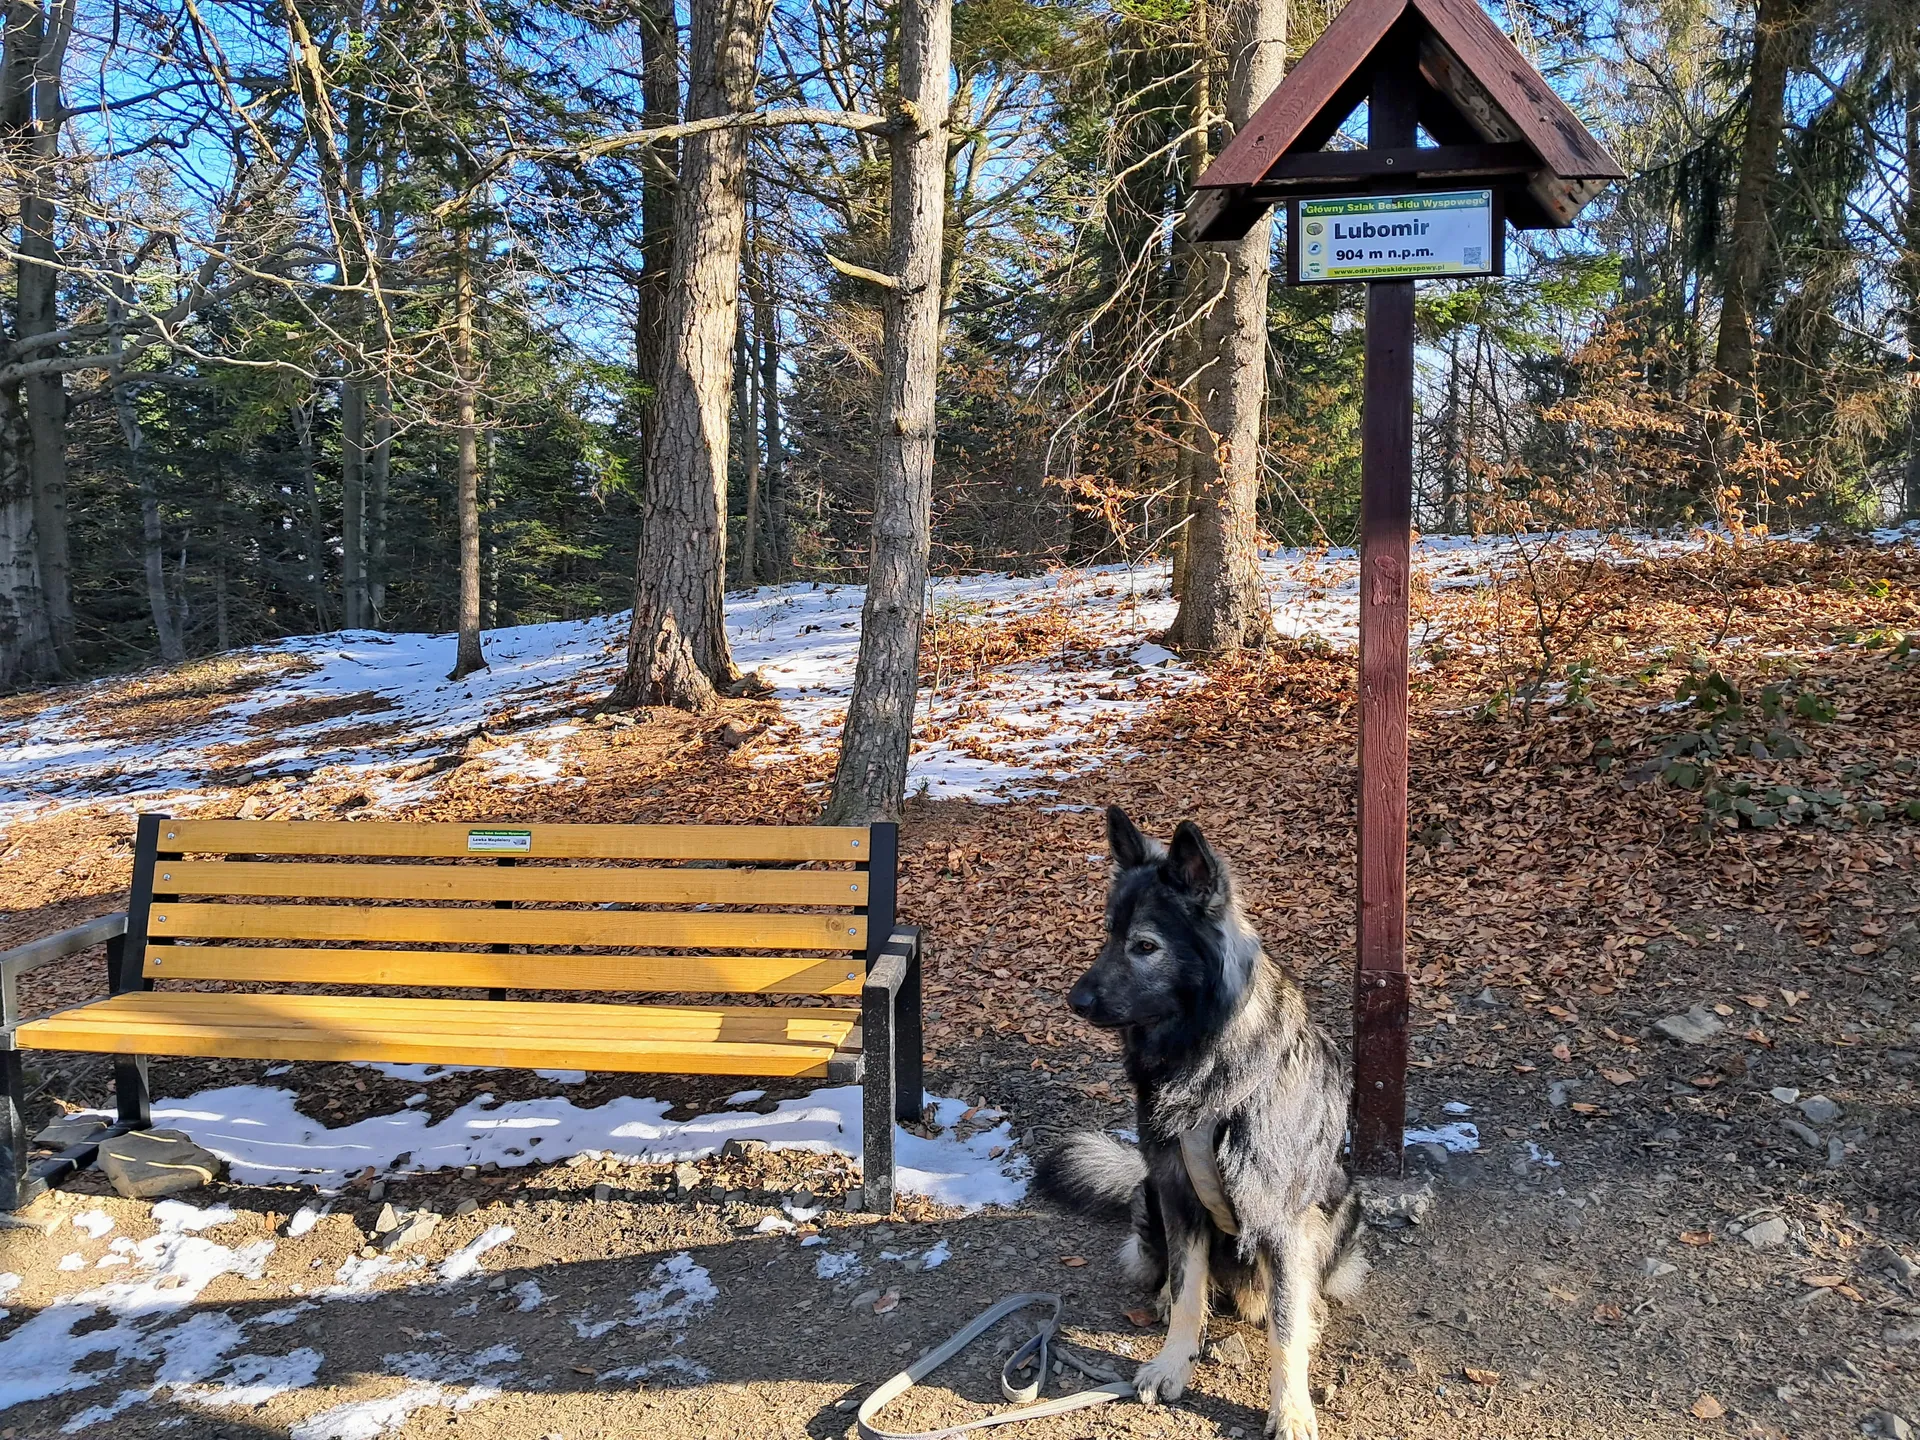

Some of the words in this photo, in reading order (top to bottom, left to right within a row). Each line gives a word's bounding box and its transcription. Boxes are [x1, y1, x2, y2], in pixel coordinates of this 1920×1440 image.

[1306, 204, 1344, 214] Główny
[1347, 202, 1375, 212] Szlak
[1378, 200, 1420, 210] Beskidu
[1422, 198, 1485, 209] Wyspowego
[1334, 218, 1430, 240] Lubomir
[1336, 249, 1364, 261] 904
[1369, 250, 1383, 259] m
[1388, 247, 1434, 260] n.p.m.
[1334, 264, 1445, 275] www.odkryjbeskidwyspowy.pl
